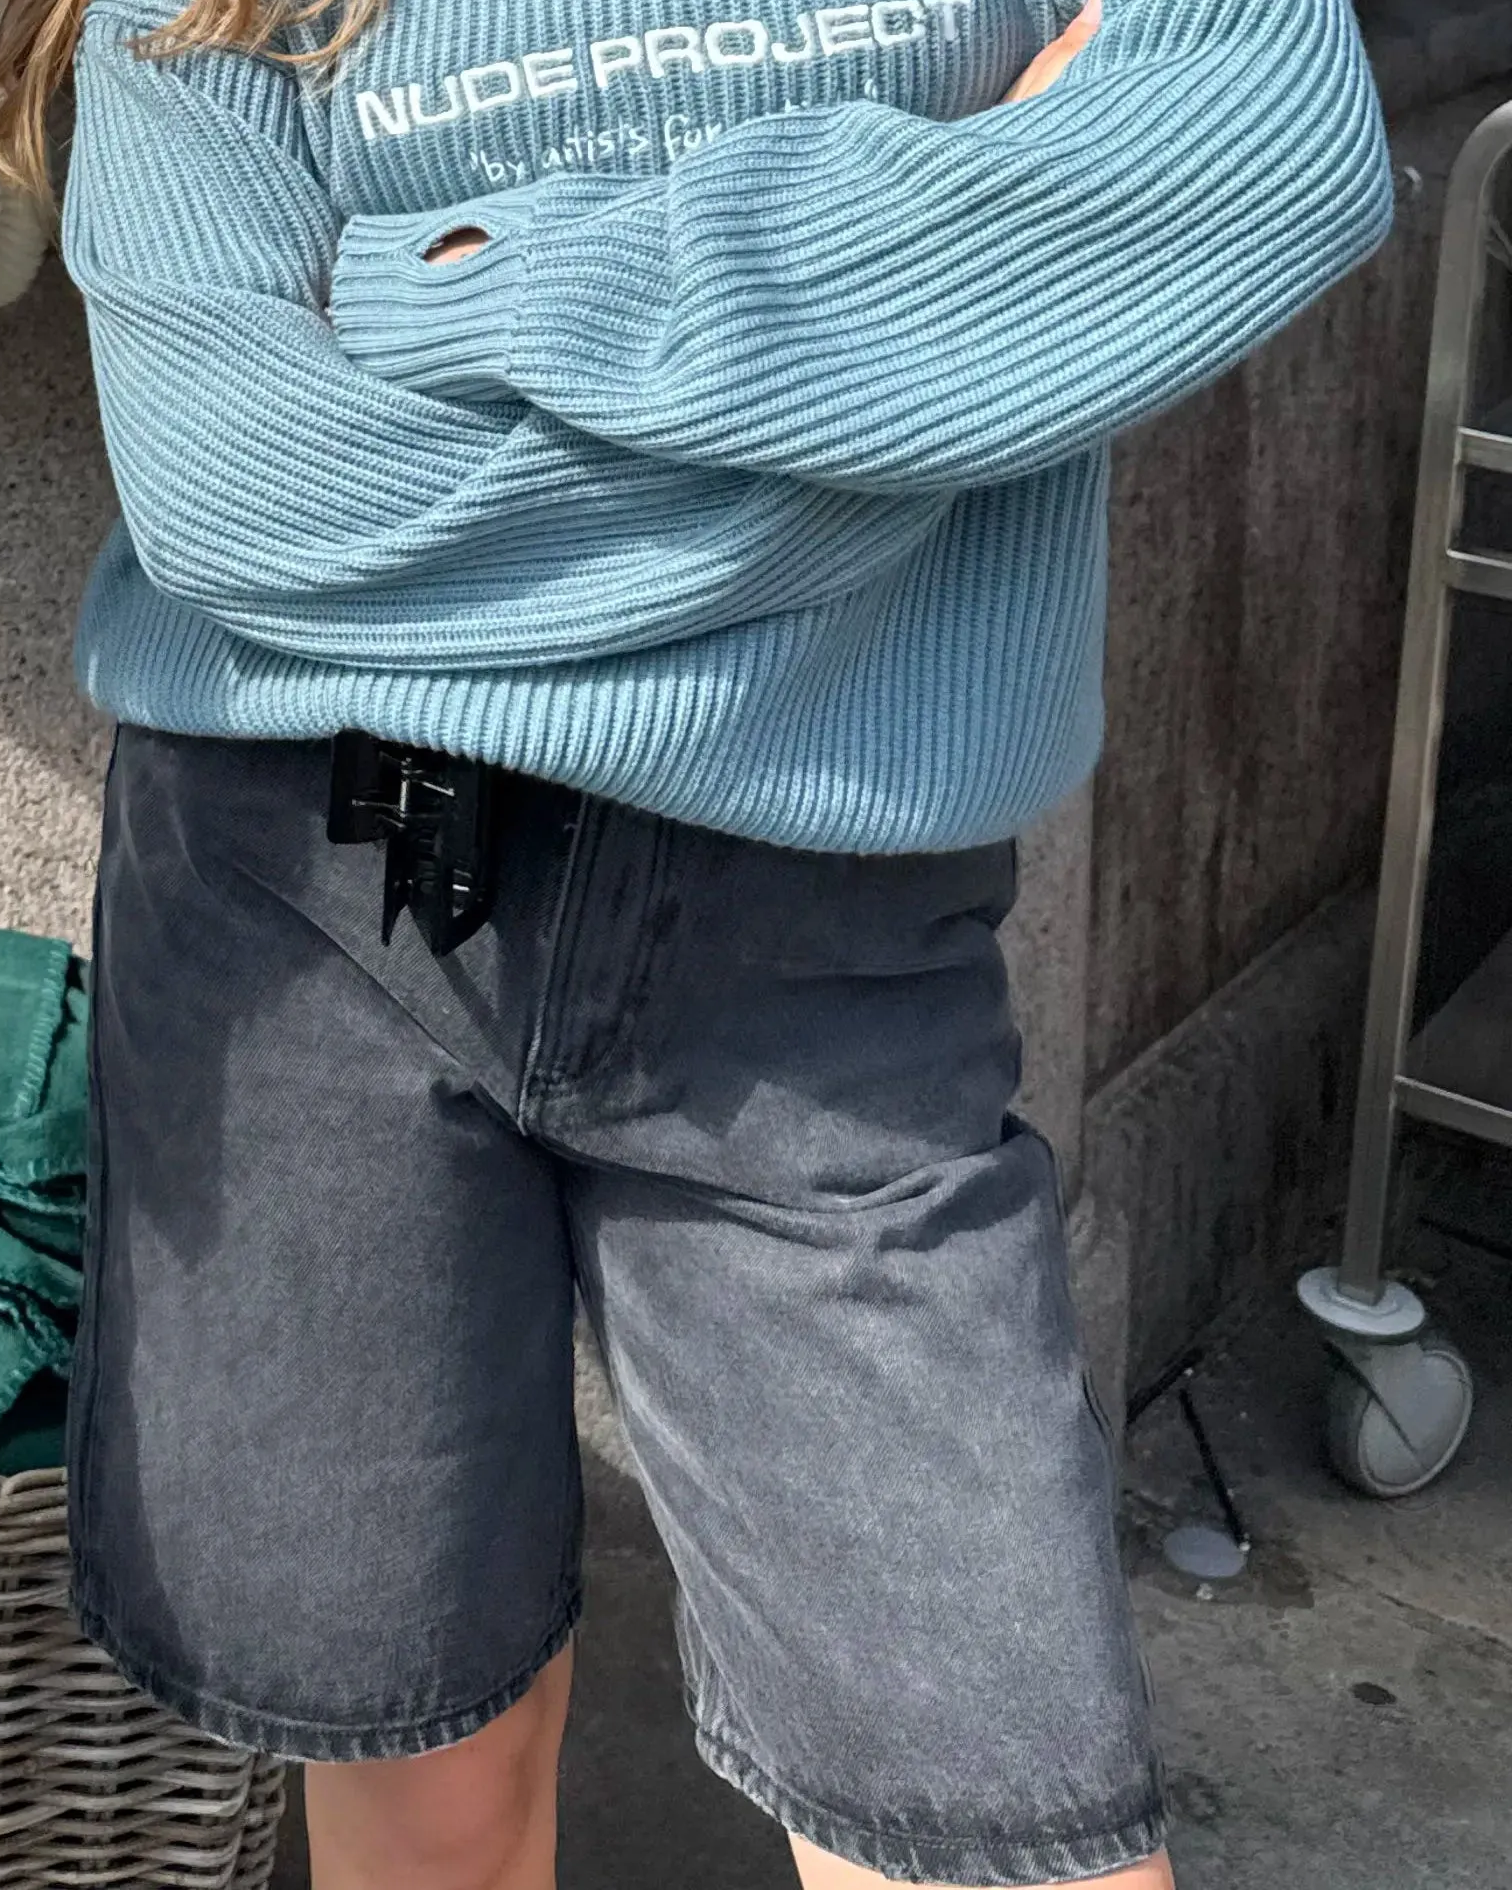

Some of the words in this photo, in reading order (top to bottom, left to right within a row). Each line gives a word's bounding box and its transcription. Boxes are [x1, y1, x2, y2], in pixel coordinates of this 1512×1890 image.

[355, 48, 578, 142] NUDE
[541, 121, 651, 170] artists
[662, 113, 726, 163] for
